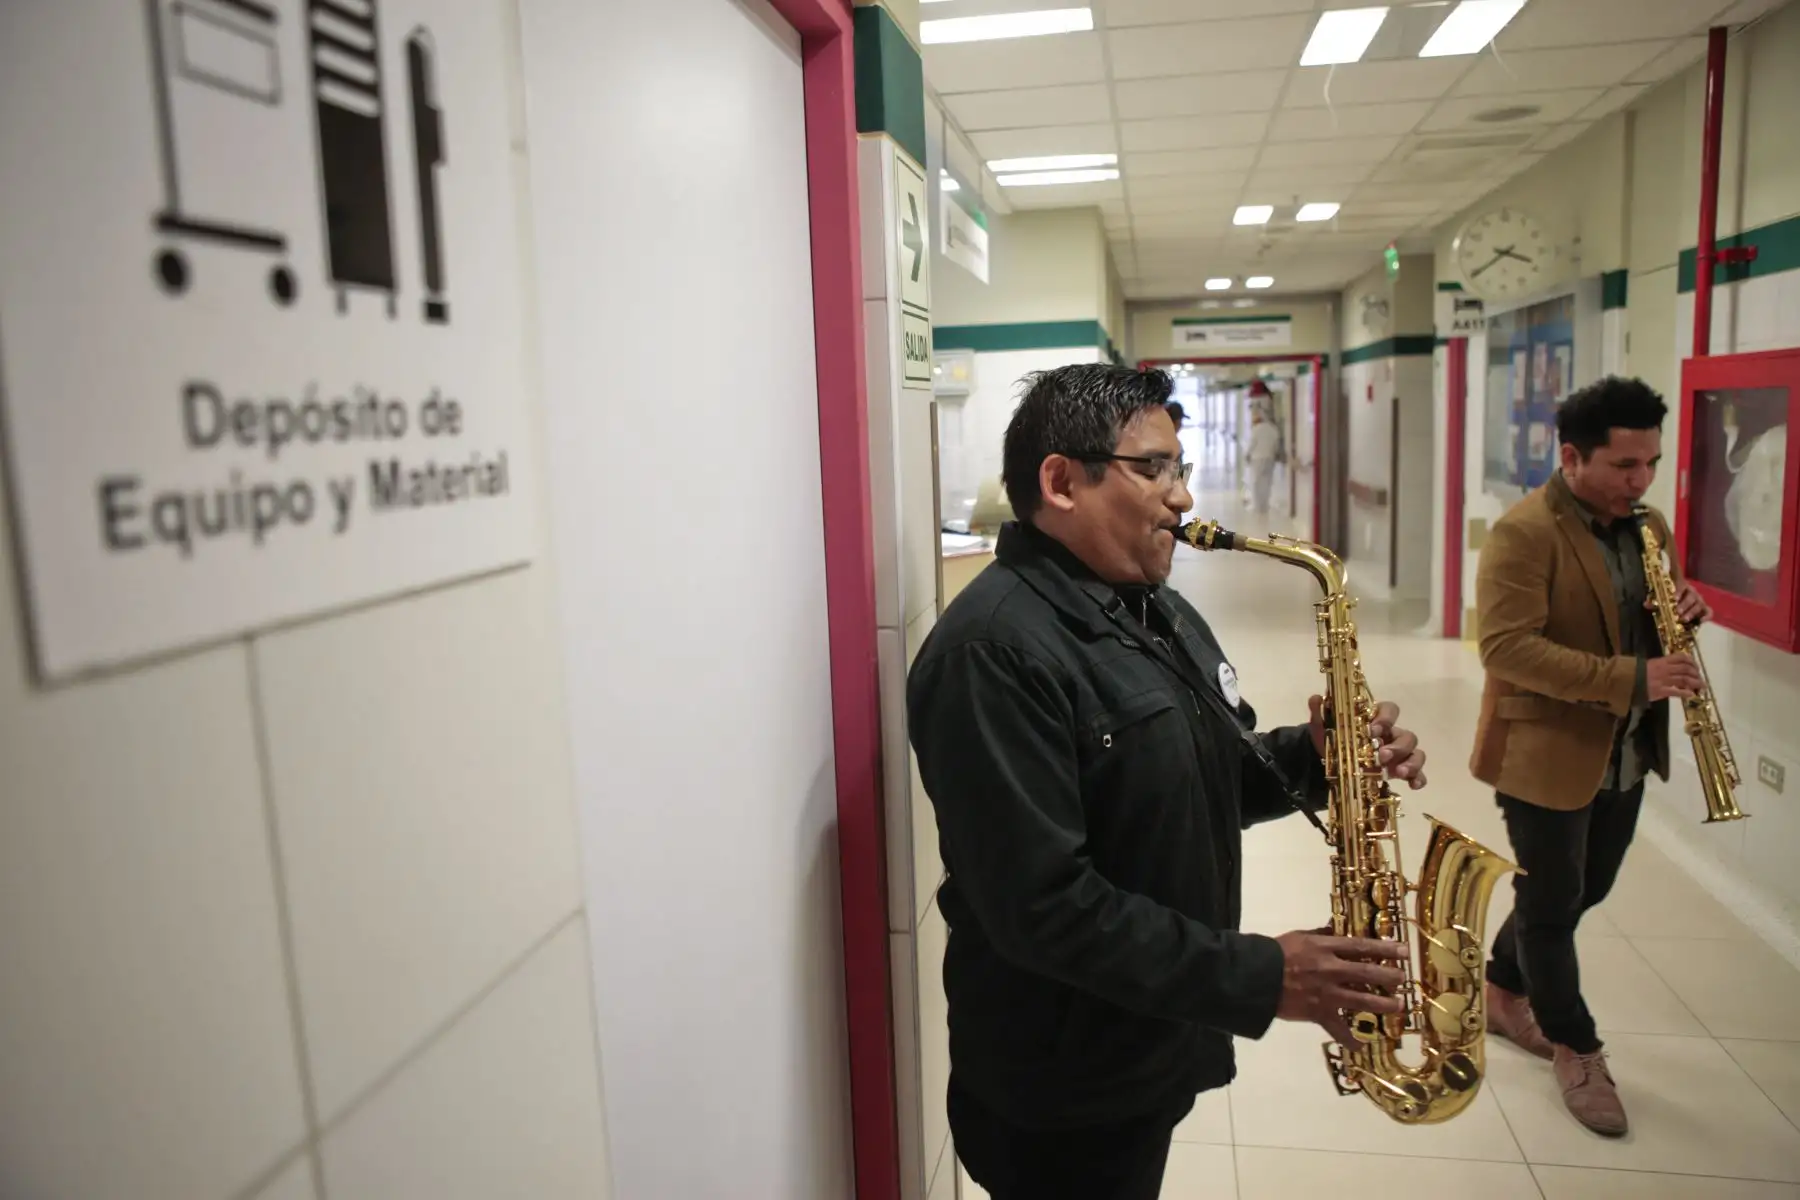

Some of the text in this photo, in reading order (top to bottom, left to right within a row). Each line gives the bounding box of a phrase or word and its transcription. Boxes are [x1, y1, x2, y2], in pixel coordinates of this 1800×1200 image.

[906, 331, 928, 362] SALIDA
[183, 380, 463, 459] Depósito de
[100, 453, 510, 557] Equipo y Material
